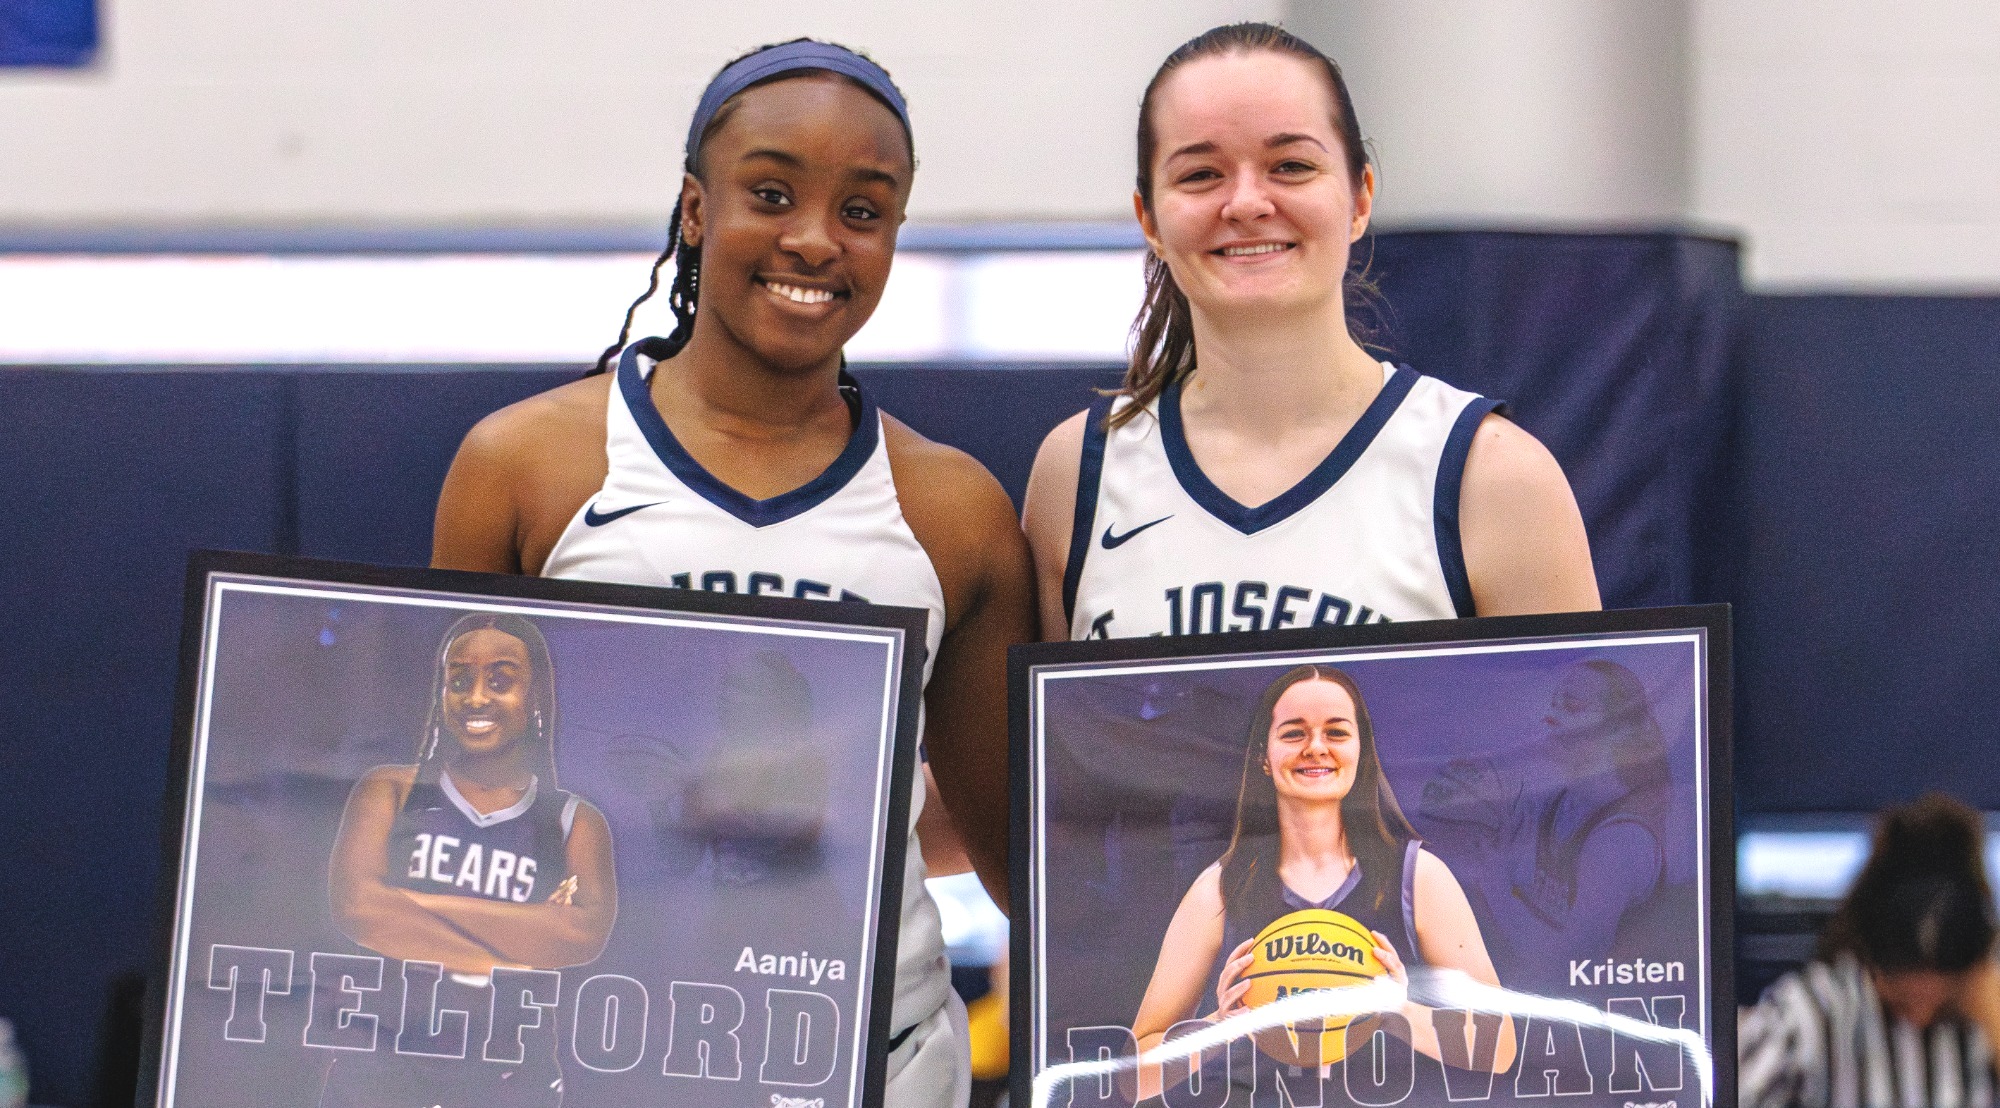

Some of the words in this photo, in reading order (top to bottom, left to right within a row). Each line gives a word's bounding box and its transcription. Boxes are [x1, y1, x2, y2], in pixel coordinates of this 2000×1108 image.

[408, 833, 538, 903] BEARS
[734, 946, 847, 985] Aaniya
[1265, 933, 1365, 966] Wilson
[1569, 957, 1685, 987] Kristen
[208, 943, 841, 1087] TELFORD
[1066, 995, 1686, 1108] DONOVAN
